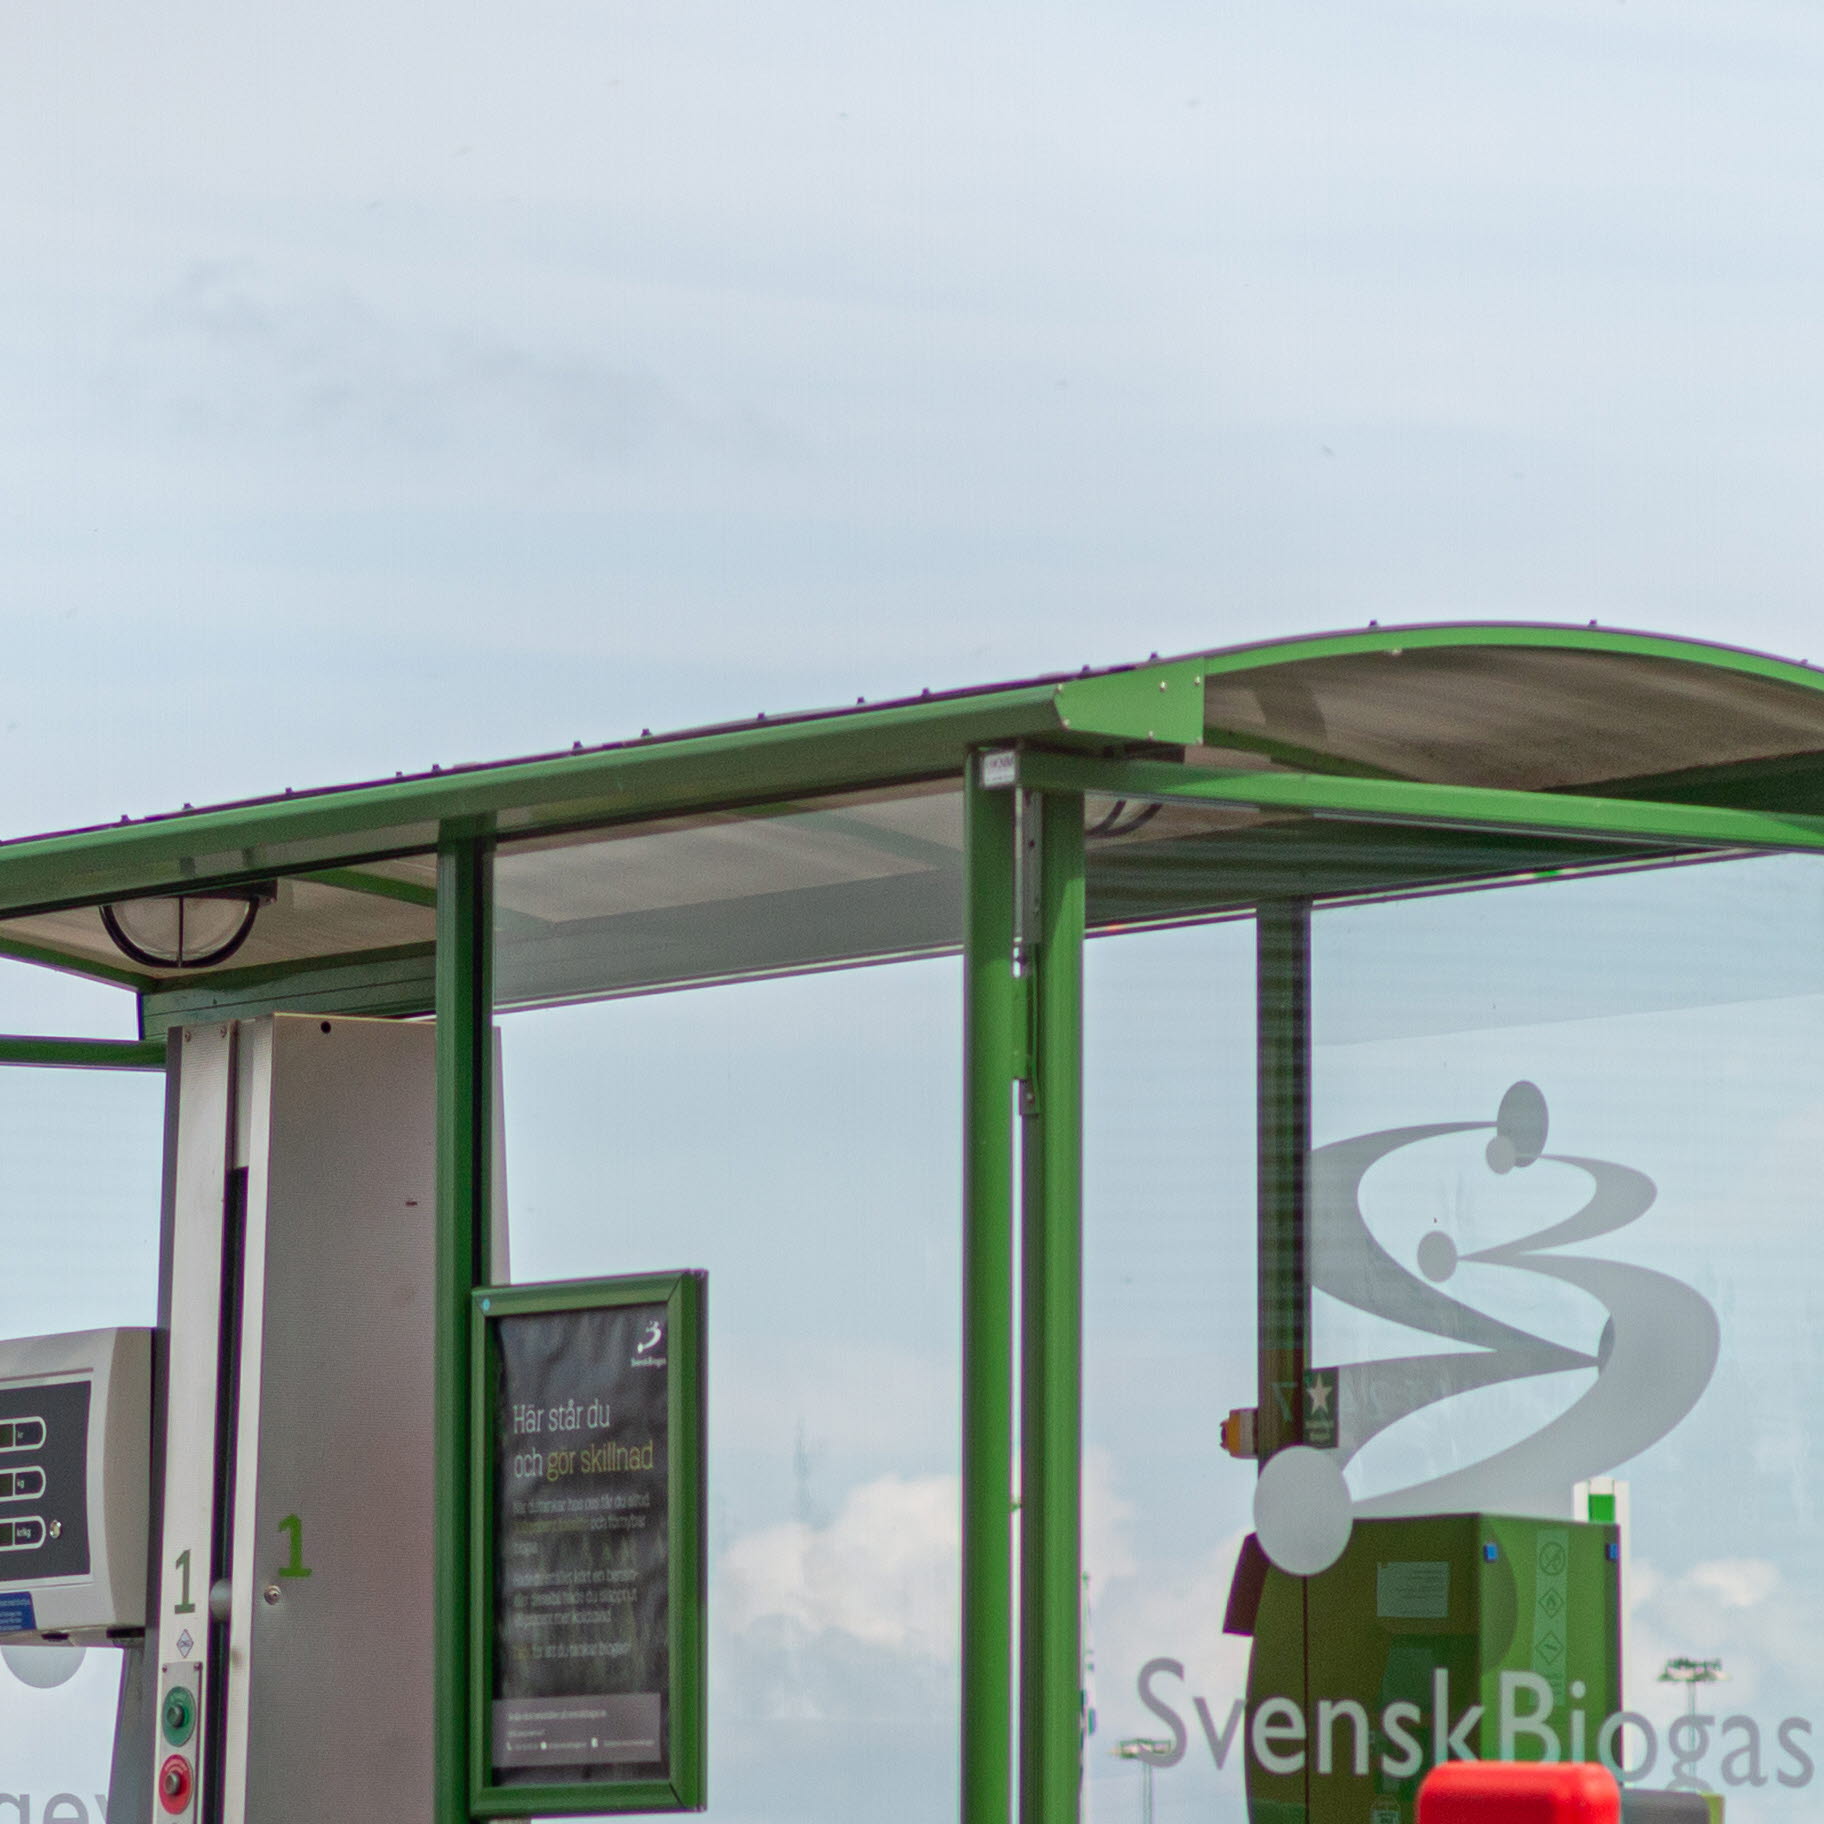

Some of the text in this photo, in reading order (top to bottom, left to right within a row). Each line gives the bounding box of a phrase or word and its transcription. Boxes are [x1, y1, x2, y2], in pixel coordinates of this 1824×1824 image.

[512, 1397, 611, 1435] Här står du
[513, 1439, 654, 1483] och gör skillnad
[278, 1512, 313, 1578] 1
[174, 1548, 196, 1615] 1
[1135, 1657, 1816, 1794] SvenskBiogas
